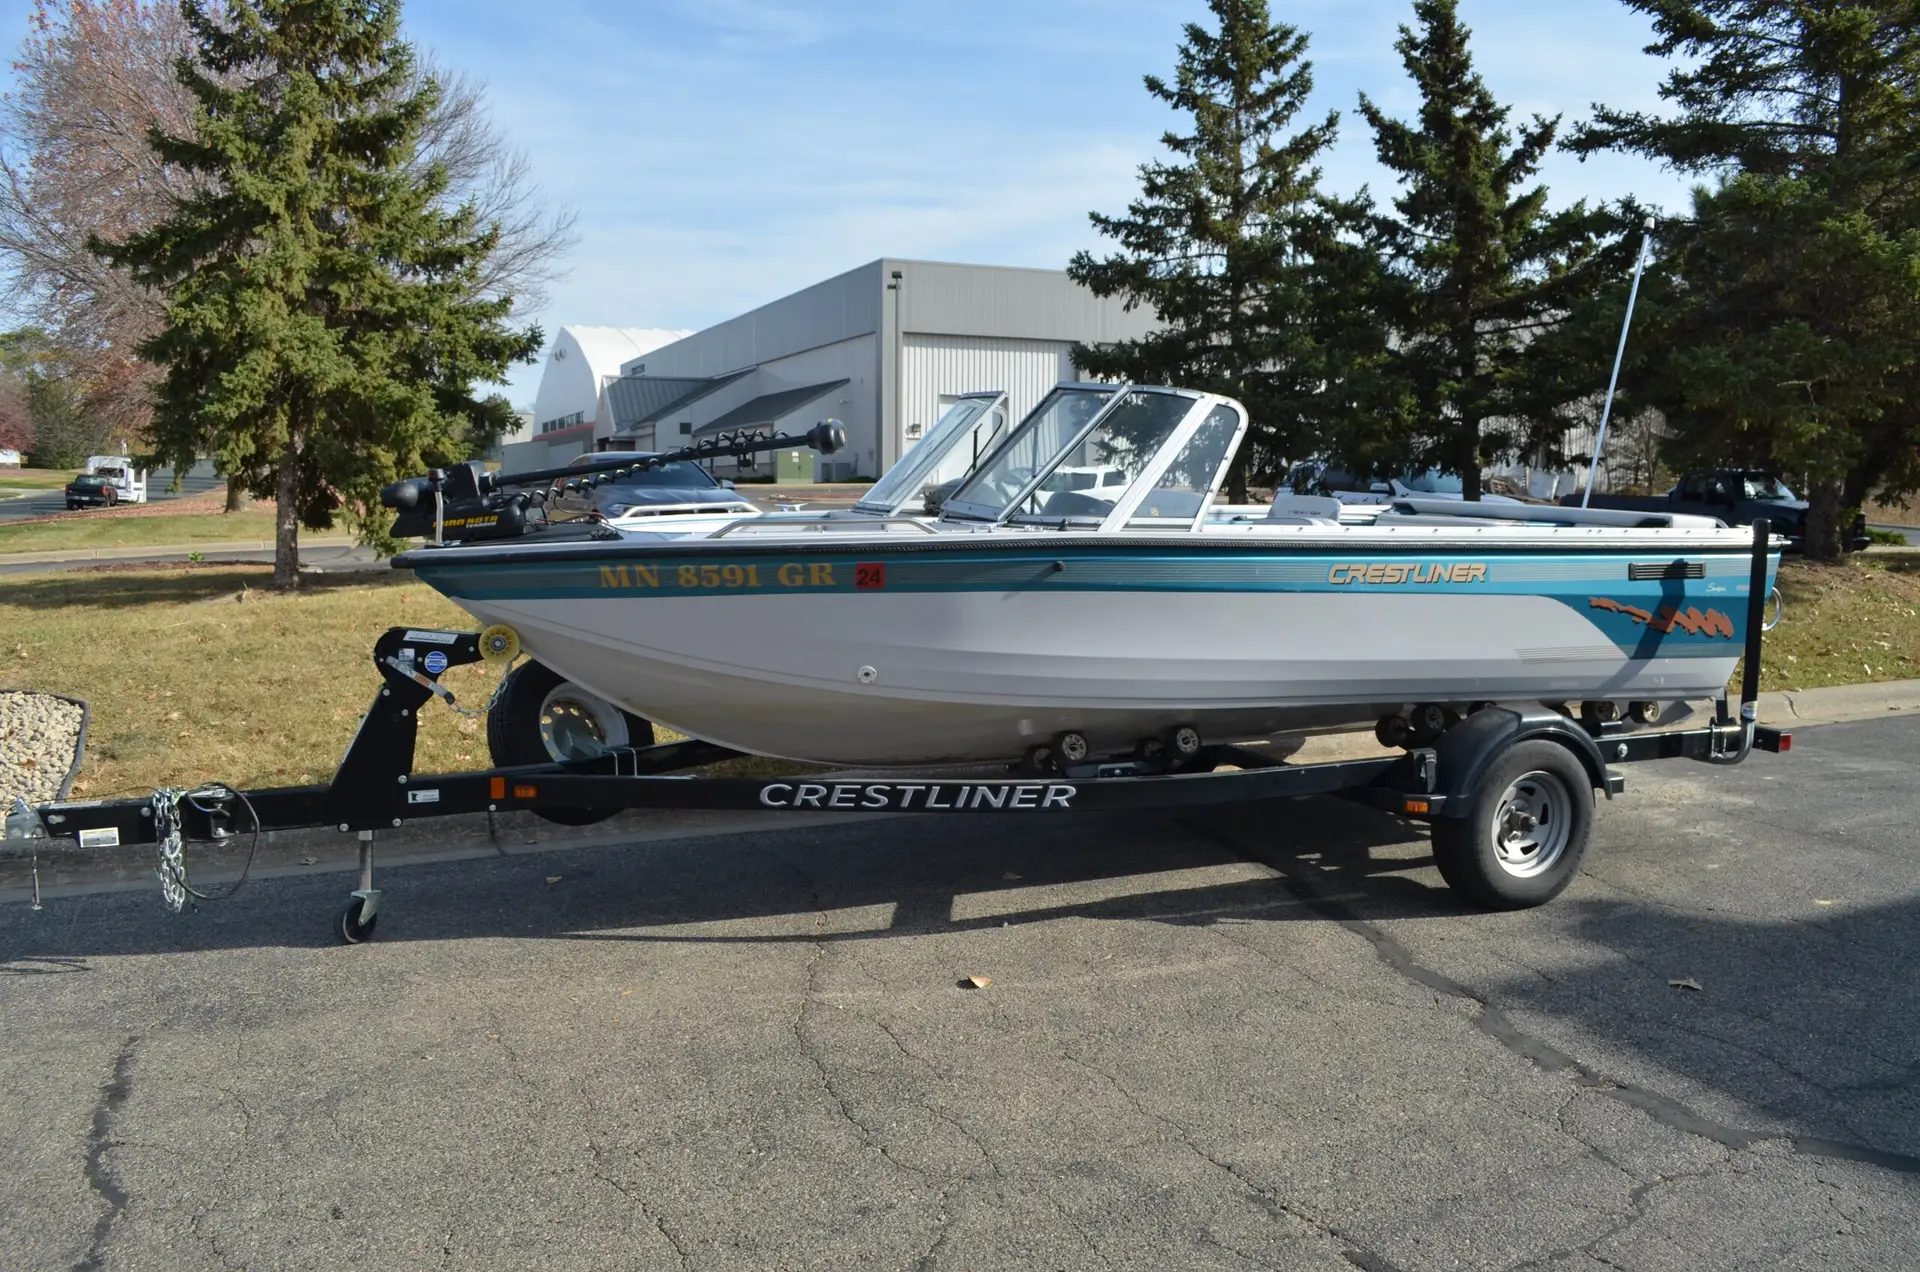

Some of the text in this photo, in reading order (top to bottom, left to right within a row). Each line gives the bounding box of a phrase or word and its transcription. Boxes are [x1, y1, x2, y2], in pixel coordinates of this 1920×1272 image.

[600, 563, 836, 588] MN 8591 GR
[857, 568, 881, 586] 24
[1327, 563, 1487, 585] CRESTLINER
[759, 783, 1077, 808] CRESTLINER
